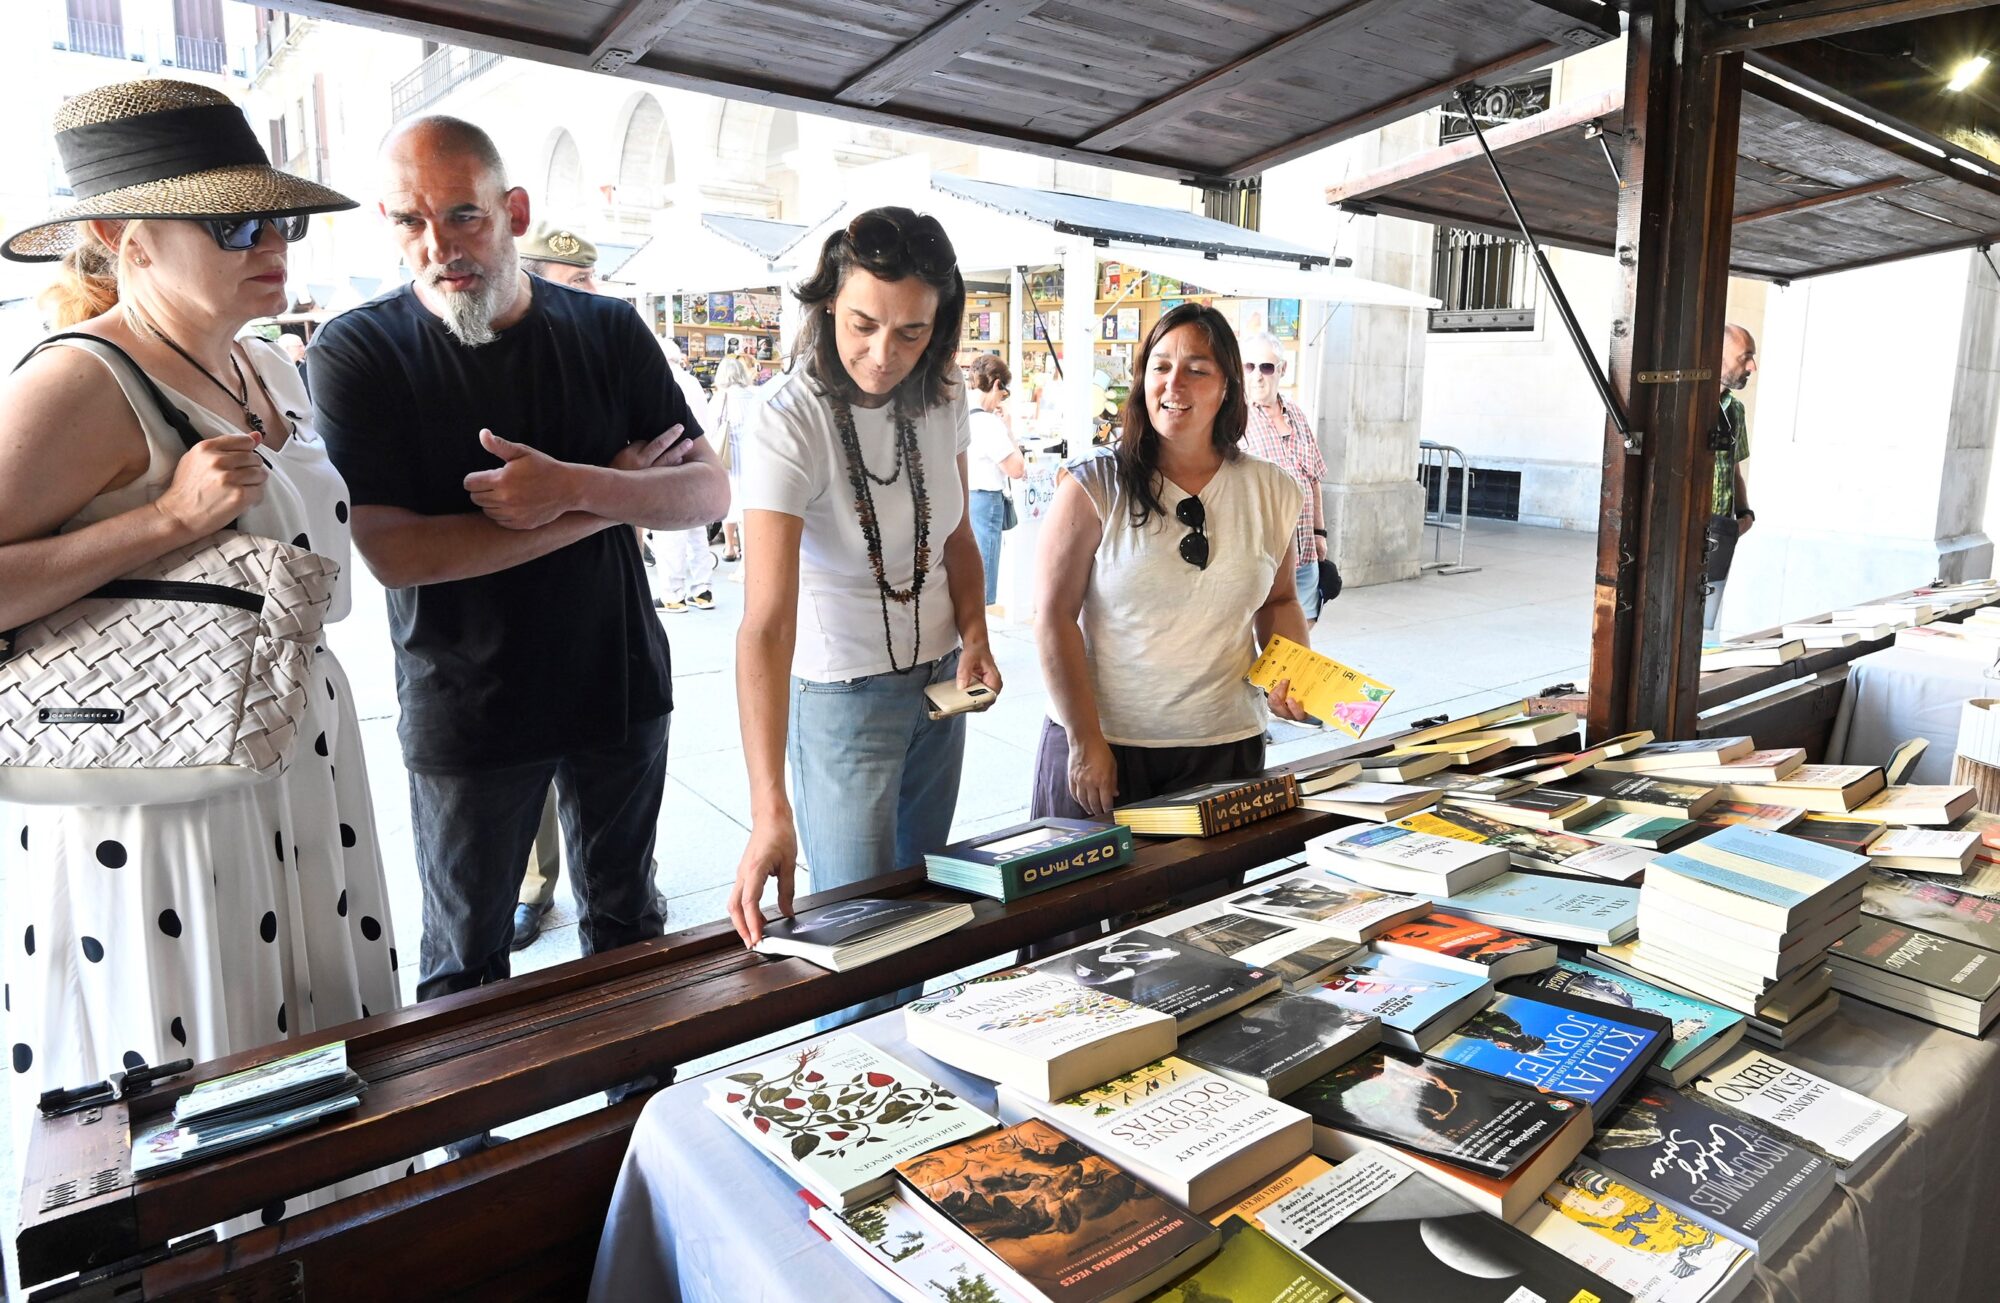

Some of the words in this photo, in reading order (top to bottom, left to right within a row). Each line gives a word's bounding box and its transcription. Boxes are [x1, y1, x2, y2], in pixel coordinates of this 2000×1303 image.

[1217, 792, 1285, 820] SAFARI
[1567, 894, 1606, 914] ISLAS
[1592, 898, 1630, 917] ATLAS
[1219, 986, 1233, 995] Esa
[1546, 971, 1572, 991] MAGAL
[945, 979, 1065, 1021] CAMINANTES
[1187, 1000, 1200, 1009] con
[1202, 992, 1218, 1002] cosa
[1372, 997, 1397, 1012] CUETO
[1379, 995, 1413, 1014] BATALLA
[1388, 1002, 1413, 1016] PABLO
[1504, 1014, 1598, 1087] JORNET
[1556, 1027, 1645, 1095] KILIAN
[1557, 1063, 1568, 1074] LOS
[1566, 1057, 1574, 1066] DE
[1541, 1073, 1559, 1090] LÍMITE
[1714, 1058, 1786, 1102] REINO
[1781, 1072, 1814, 1091] ES
[1761, 1083, 1796, 1104] MI
[1814, 1083, 1830, 1099] LA
[1111, 1081, 1229, 1141] OCULTAS
[1772, 1091, 1819, 1122] MONTAÑA
[1132, 1090, 1250, 1150] ESTACIONES
[1195, 1117, 1225, 1133] LAS
[1226, 1106, 1278, 1134] TRISTAN
[910, 1121, 967, 1149] HILDEGARDA
[896, 1146, 909, 1155] DE
[1176, 1131, 1228, 1162] GOOLEY
[1485, 1144, 1511, 1167] malayo
[1650, 1128, 1706, 1179] Soria
[1677, 1123, 1755, 1185] Carlos
[1748, 1135, 1794, 1163] LOS
[854, 1153, 893, 1173] BINGEN
[1804, 1157, 1822, 1176] CARLOS
[1262, 1175, 1292, 1196] GLORIA
[1689, 1150, 1777, 1215] OCHOMILES
[1784, 1184, 1792, 1192] Y
[1787, 1173, 1804, 1190] SORIA
[1237, 1192, 1264, 1212] DICKIE
[1302, 1191, 1312, 1199] SEAN
[1774, 1190, 1788, 1203] SITO
[1742, 1199, 1776, 1231] CARCAVILLA
[1137, 1218, 1184, 1248] NUESTRAS
[1091, 1243, 1138, 1272] PRIMERAS
[1594, 1256, 1615, 1275] contin
[1059, 1266, 1092, 1288] VECES
